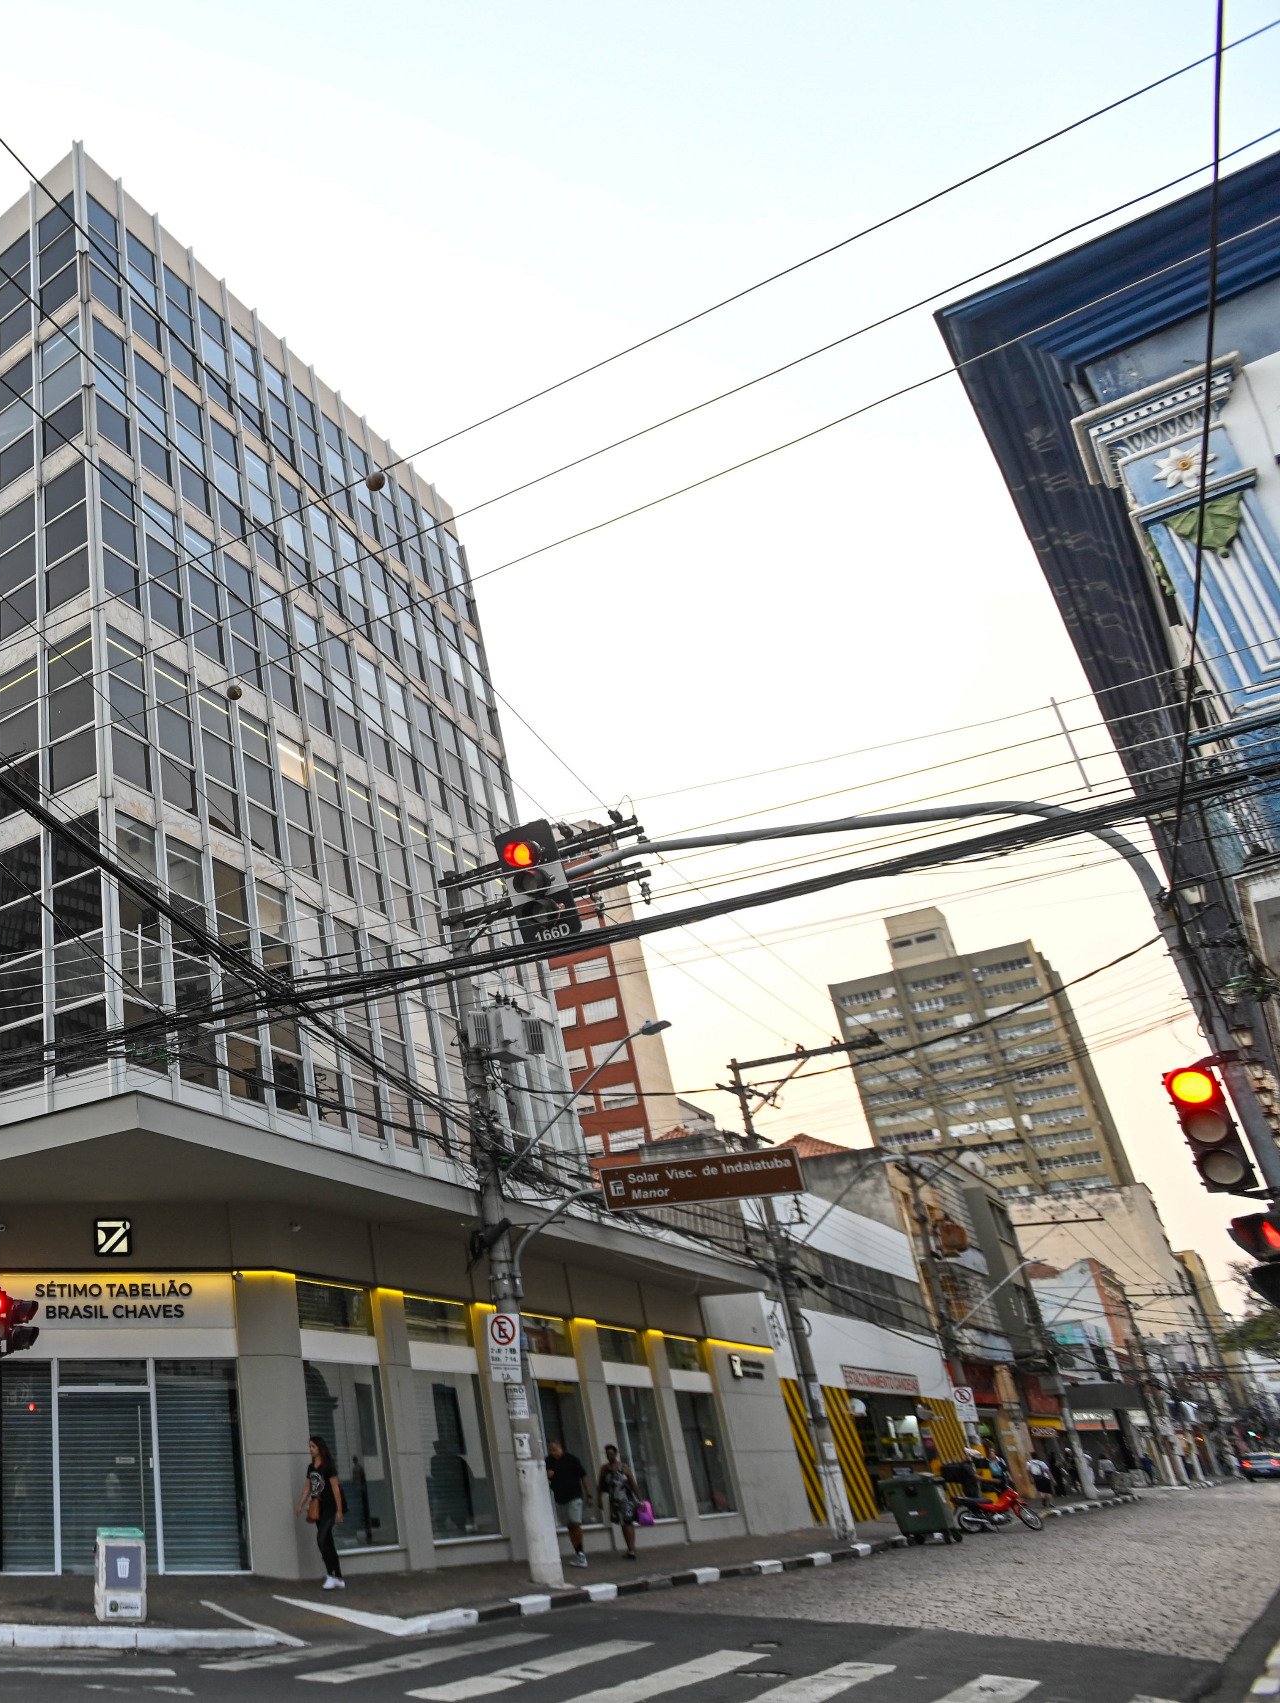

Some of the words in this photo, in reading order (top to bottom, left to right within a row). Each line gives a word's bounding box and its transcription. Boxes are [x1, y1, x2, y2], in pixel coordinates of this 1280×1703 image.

[535, 923, 571, 942] 166D
[627, 1171, 660, 1184] Solar
[665, 1168, 697, 1181] Visc.
[702, 1164, 719, 1176] de
[722, 1156, 792, 1175] Indaiatuba
[631, 1188, 670, 1201] Manor
[35, 1281, 103, 1298] SÉTIMO
[106, 1280, 193, 1298] TABELIÃO
[45, 1305, 108, 1320] BRASIL
[112, 1304, 185, 1319] CHAVES
